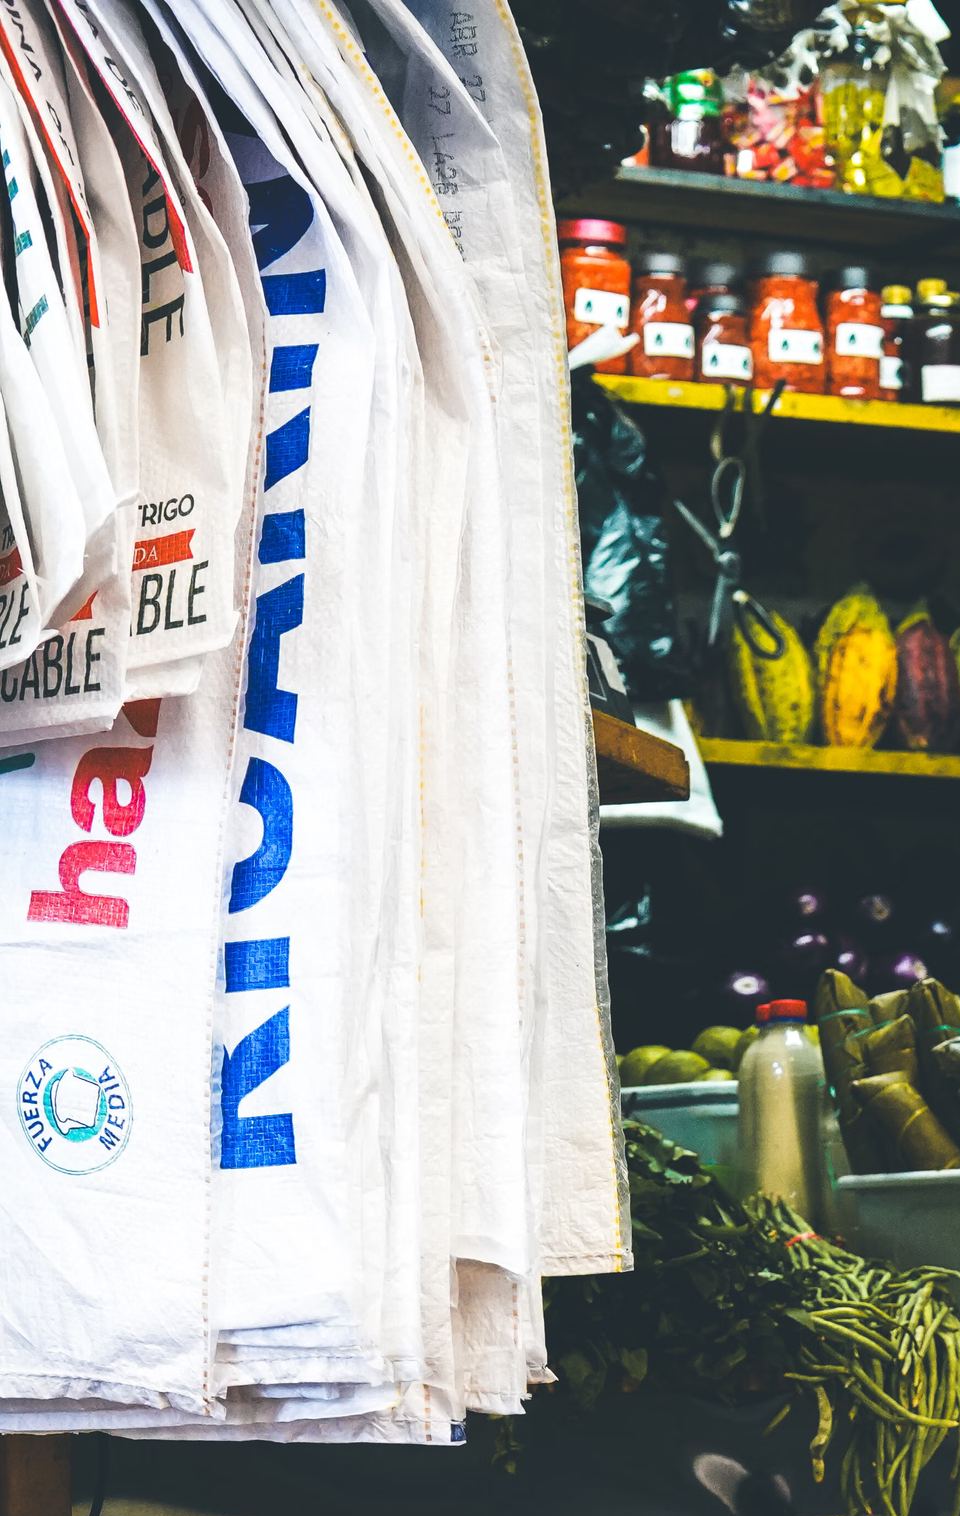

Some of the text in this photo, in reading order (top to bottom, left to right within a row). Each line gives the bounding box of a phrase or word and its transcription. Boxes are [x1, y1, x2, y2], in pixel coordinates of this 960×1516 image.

[138, 493, 195, 527] RIGO
[130, 560, 209, 638] BLE
[22, 1058, 54, 1153] FUERZA
[98, 1065, 126, 1151] MEDIA
